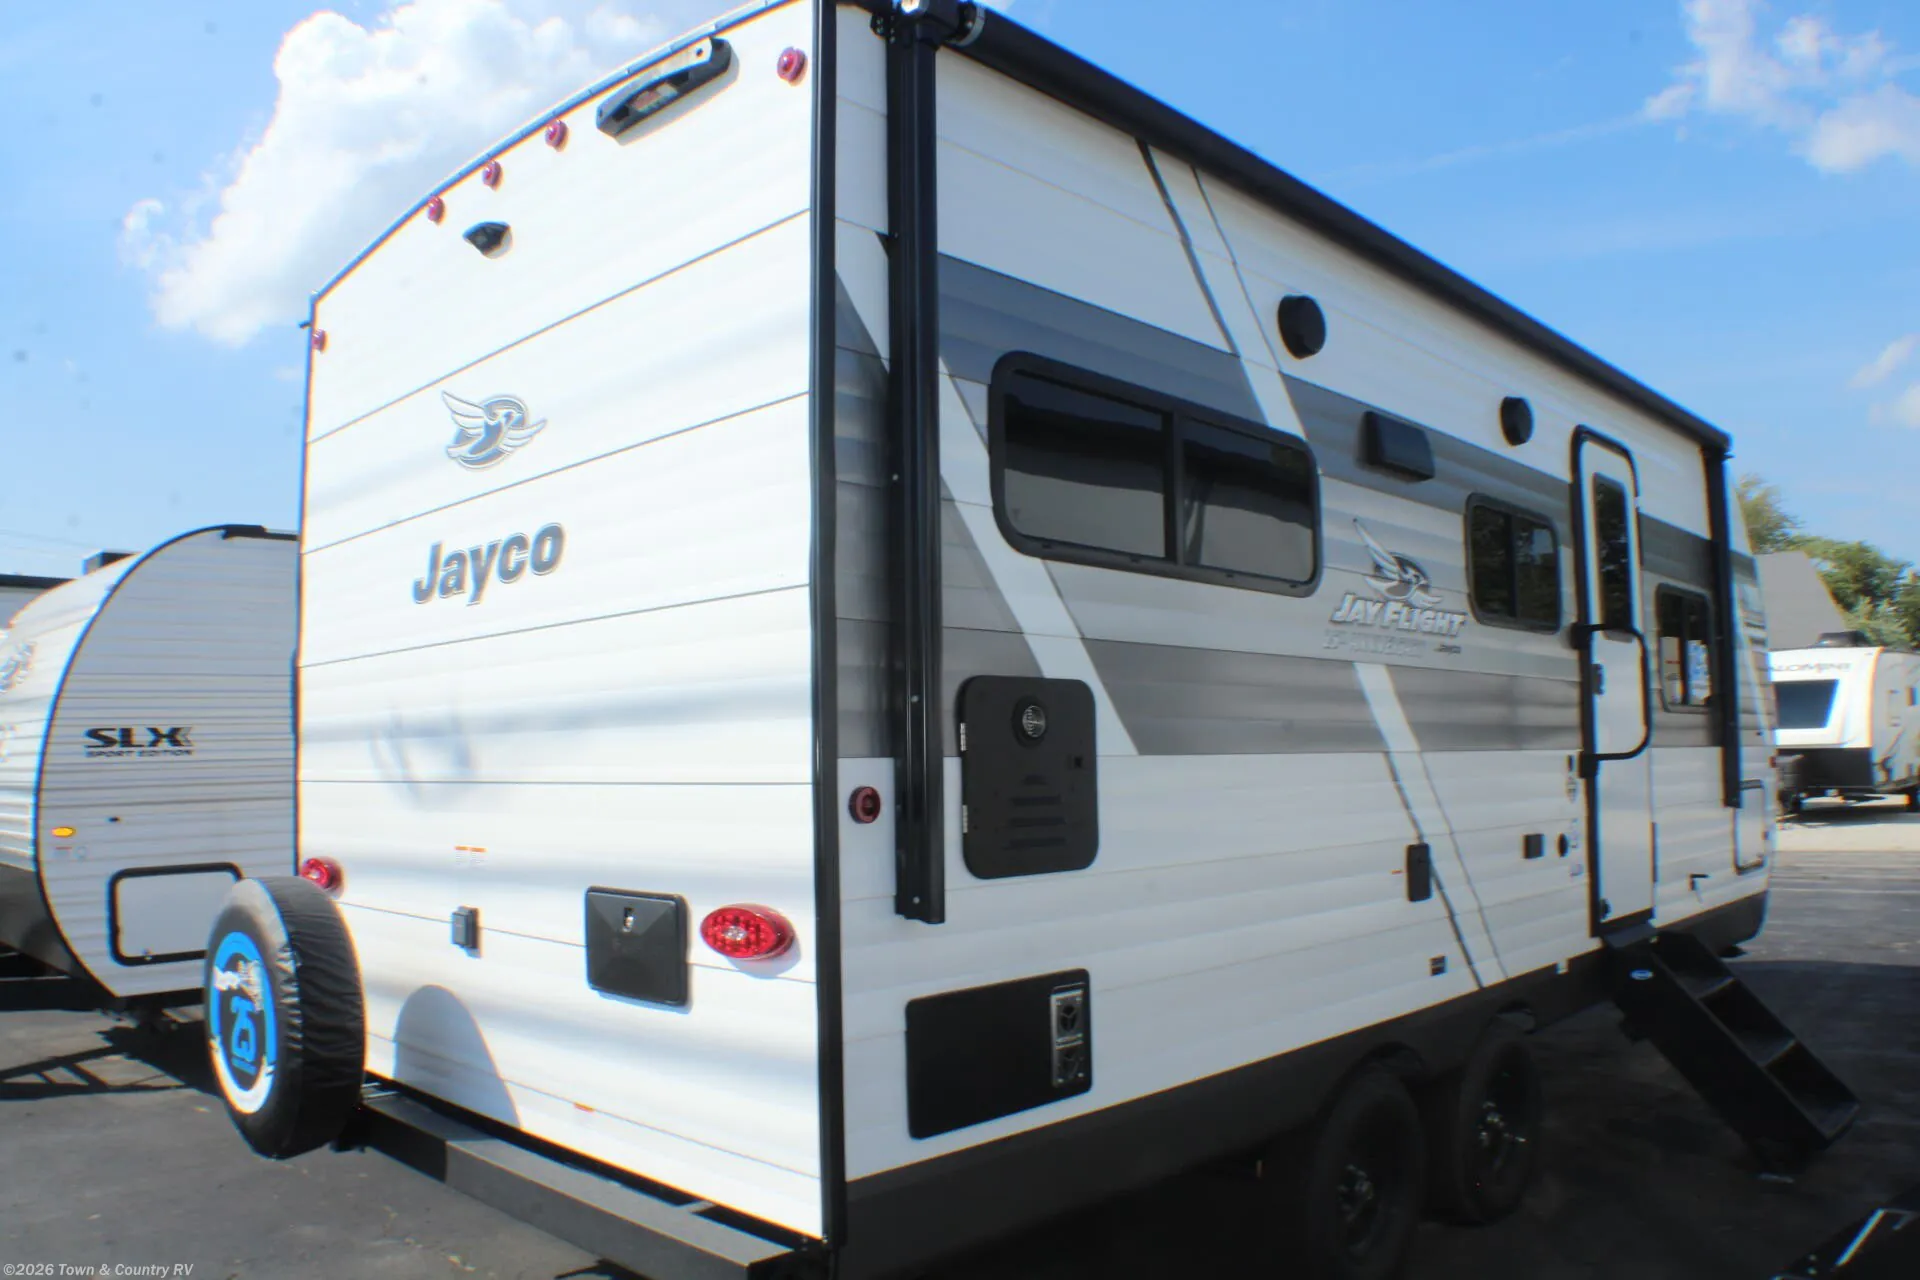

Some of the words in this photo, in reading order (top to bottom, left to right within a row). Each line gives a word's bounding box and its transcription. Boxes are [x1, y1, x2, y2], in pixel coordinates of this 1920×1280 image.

[412, 522, 566, 606] Jayco
[1331, 591, 1383, 626] JAY
[1382, 600, 1468, 637] FLIGHT
[84, 727, 191, 748] SLX
